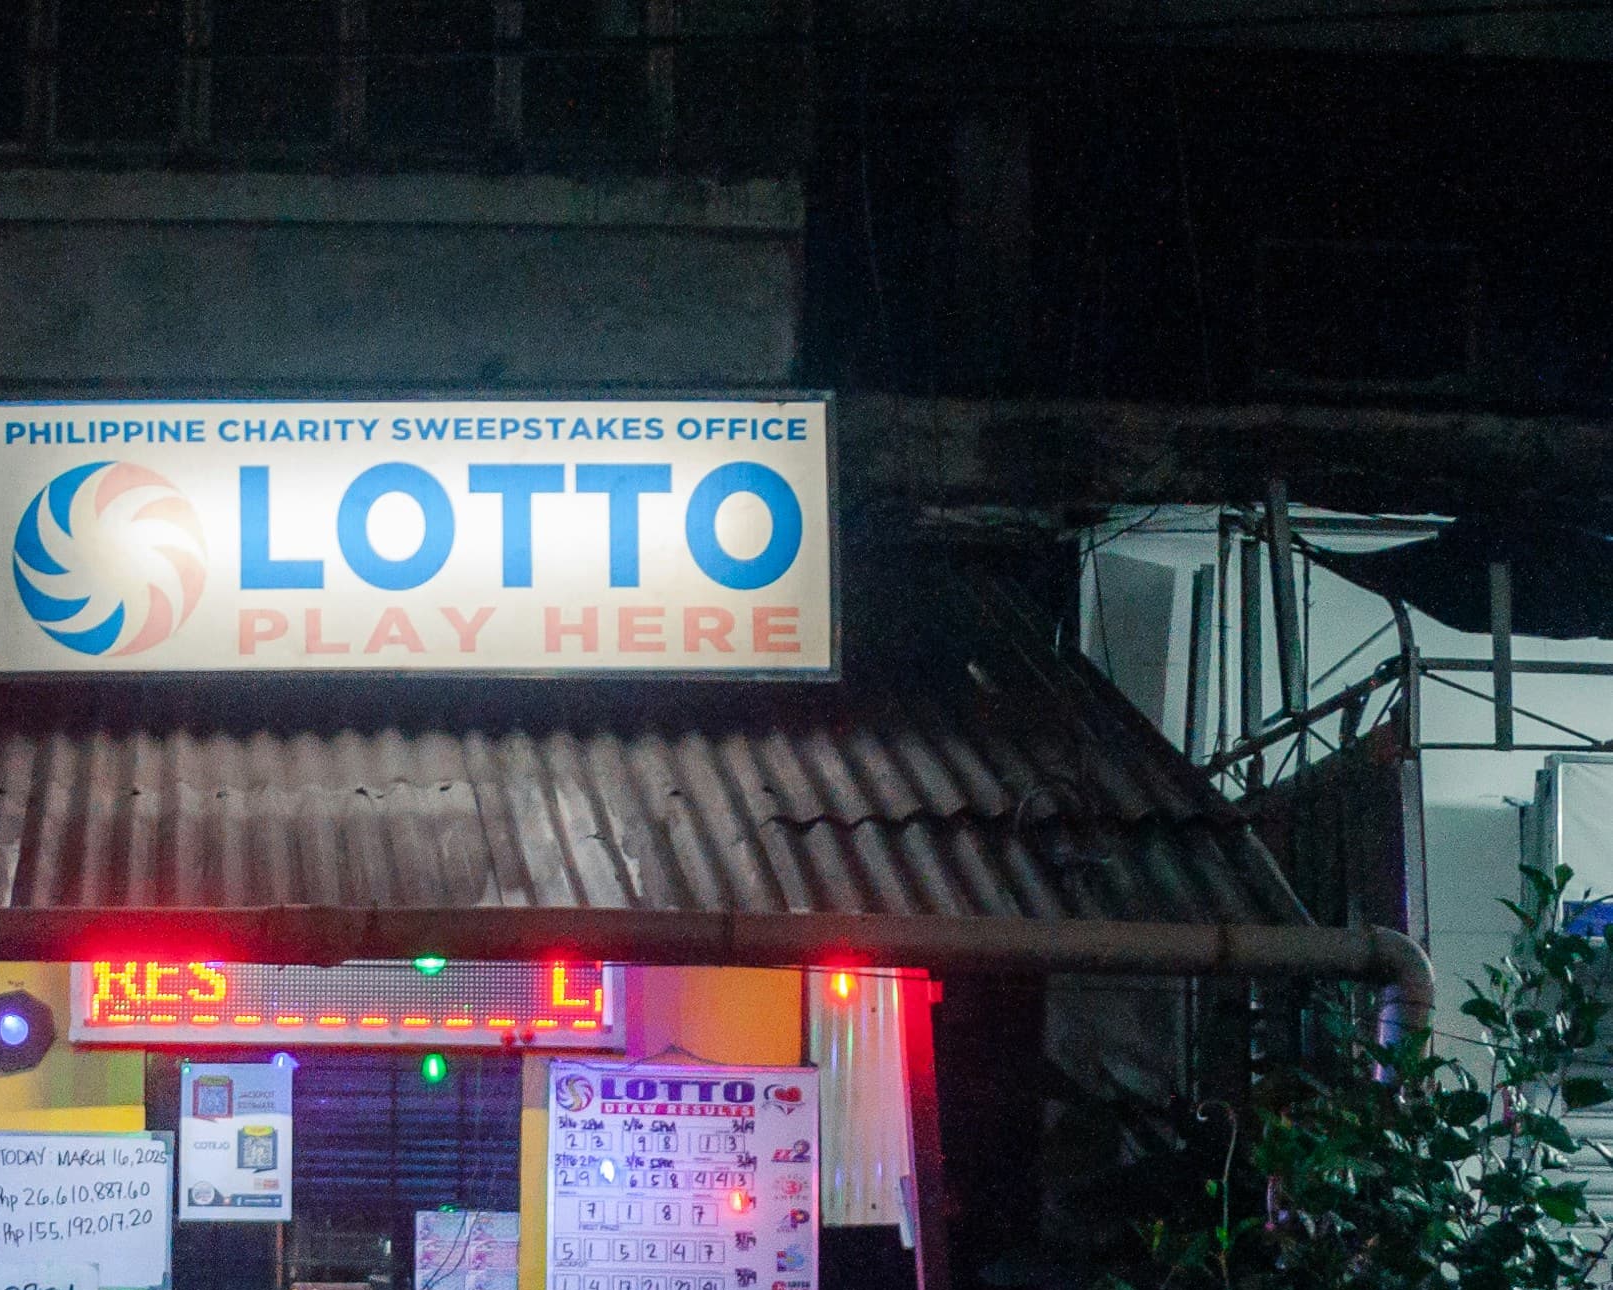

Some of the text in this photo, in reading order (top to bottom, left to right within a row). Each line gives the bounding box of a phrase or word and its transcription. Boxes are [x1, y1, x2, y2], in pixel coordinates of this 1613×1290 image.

[5, 416, 808, 446] PHILIPPINE CHARITY SWEEPSTAKES OFFICE
[239, 460, 804, 593] LOTTO
[238, 606, 802, 656] PLAY HERE
[600, 1077, 756, 1103] LOTTO
[605, 1103, 752, 1117] DRAW RESULTS
[567, 1133, 604, 1148] 2 3
[637, 1135, 671, 1152] 9 8
[728, 1136, 738, 1151] 3
[0, 1146, 47, 1167] TODAY
[57, 1148, 106, 1167] MARCH
[135, 1147, 167, 1165] 2025
[558, 1169, 574, 1186] 2
[629, 1174, 638, 1188] 6
[662, 1204, 672, 1221] 8
[562, 1242, 574, 1260] 5
[620, 1244, 630, 1260] 5
[646, 1243, 658, 1259] 2
[673, 1243, 686, 1260] 4
